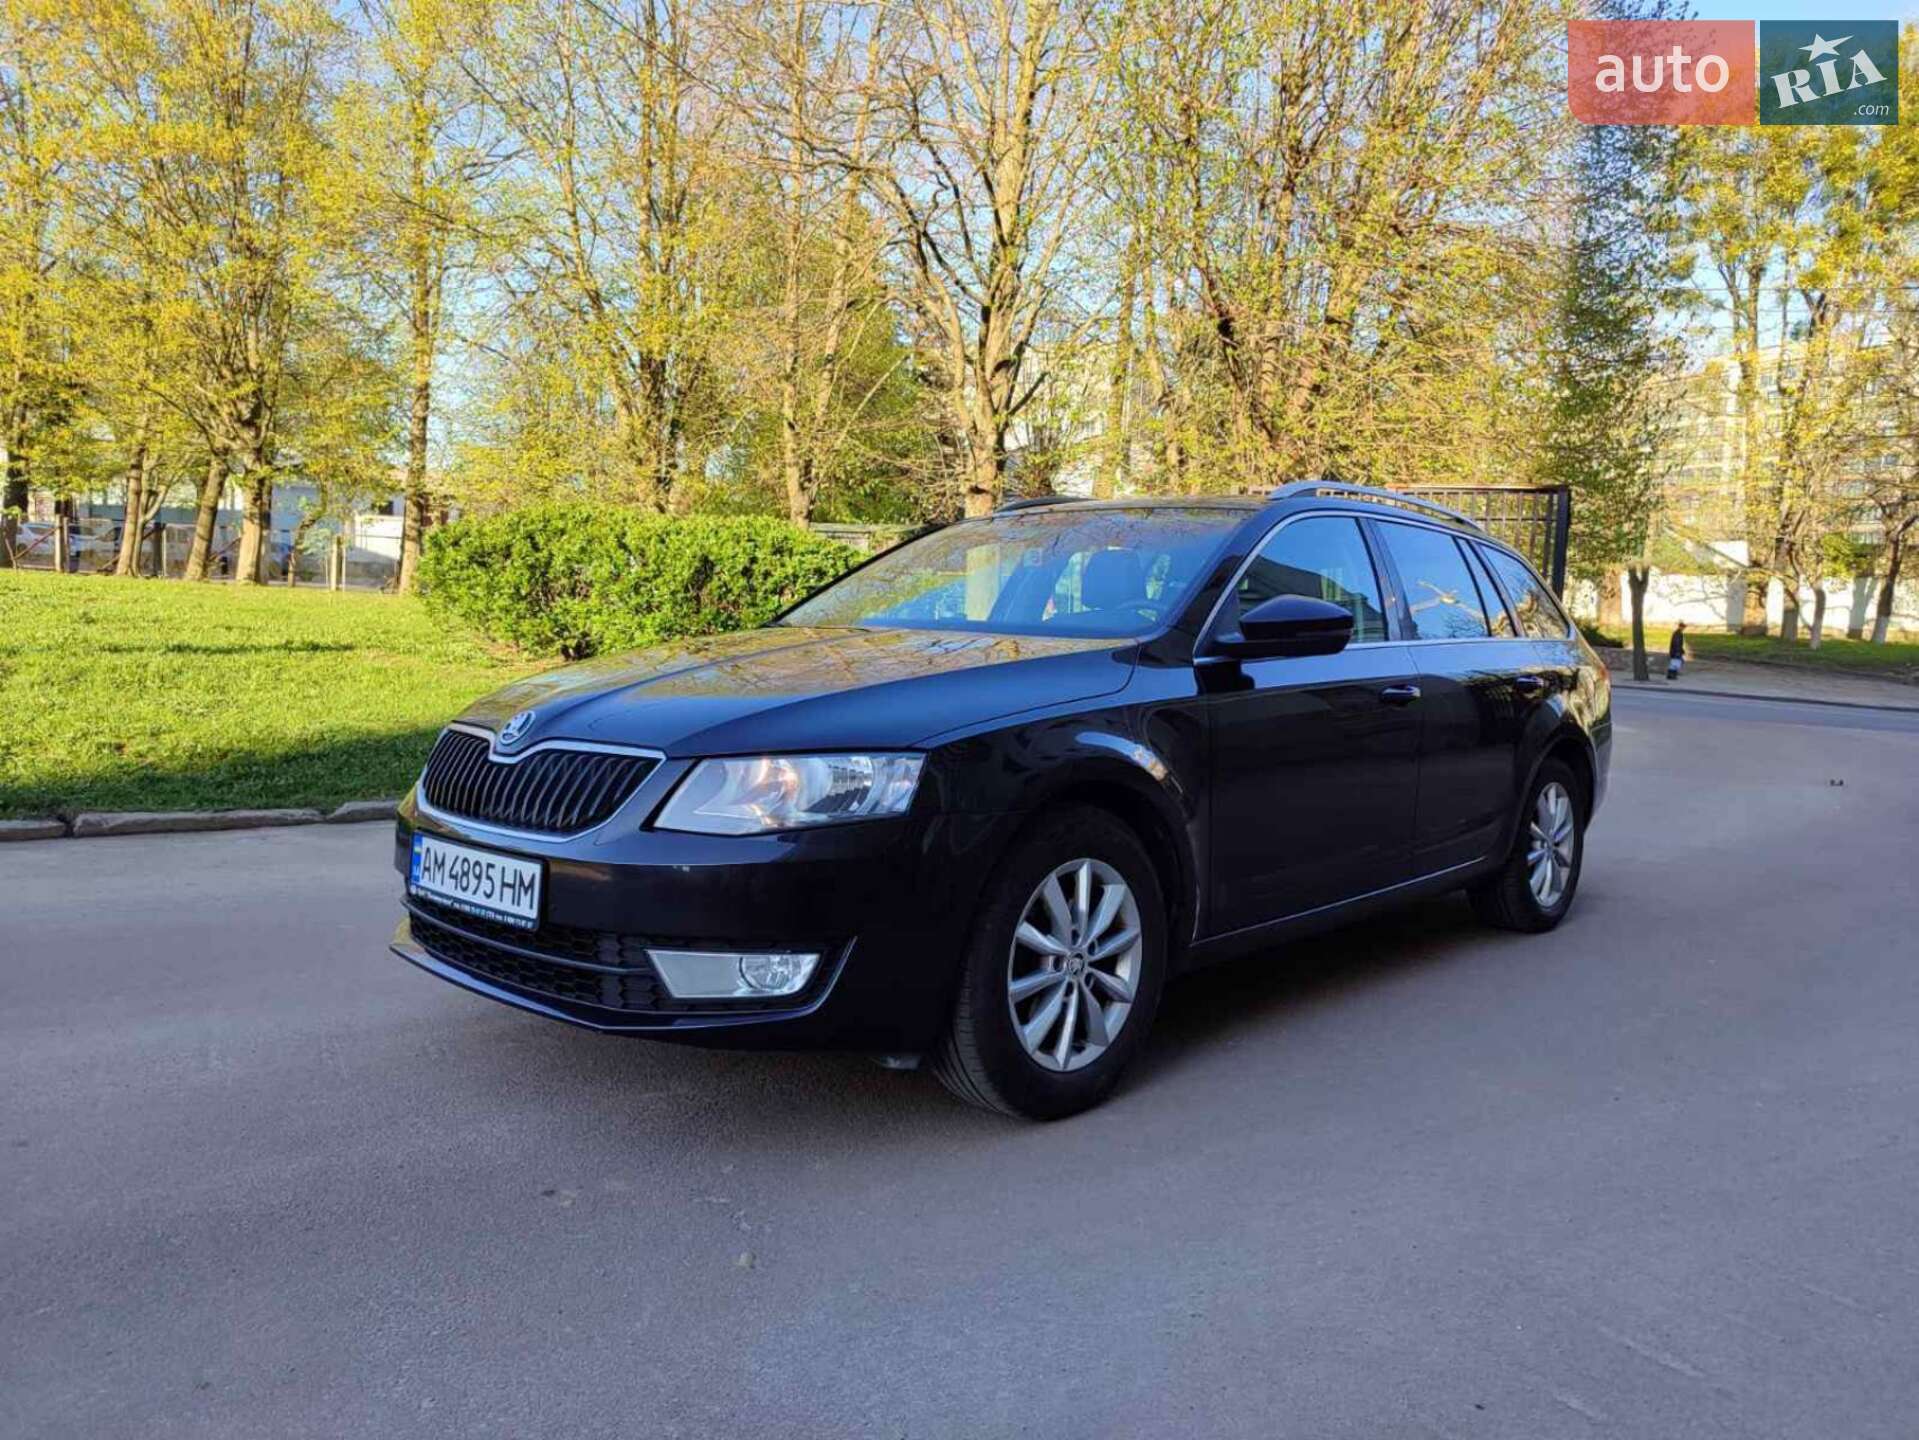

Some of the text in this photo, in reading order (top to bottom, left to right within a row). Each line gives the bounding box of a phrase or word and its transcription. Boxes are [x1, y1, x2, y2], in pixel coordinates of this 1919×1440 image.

[422, 847, 446, 886] AM
[449, 855, 496, 899] 4895
[500, 866, 535, 910] HM
